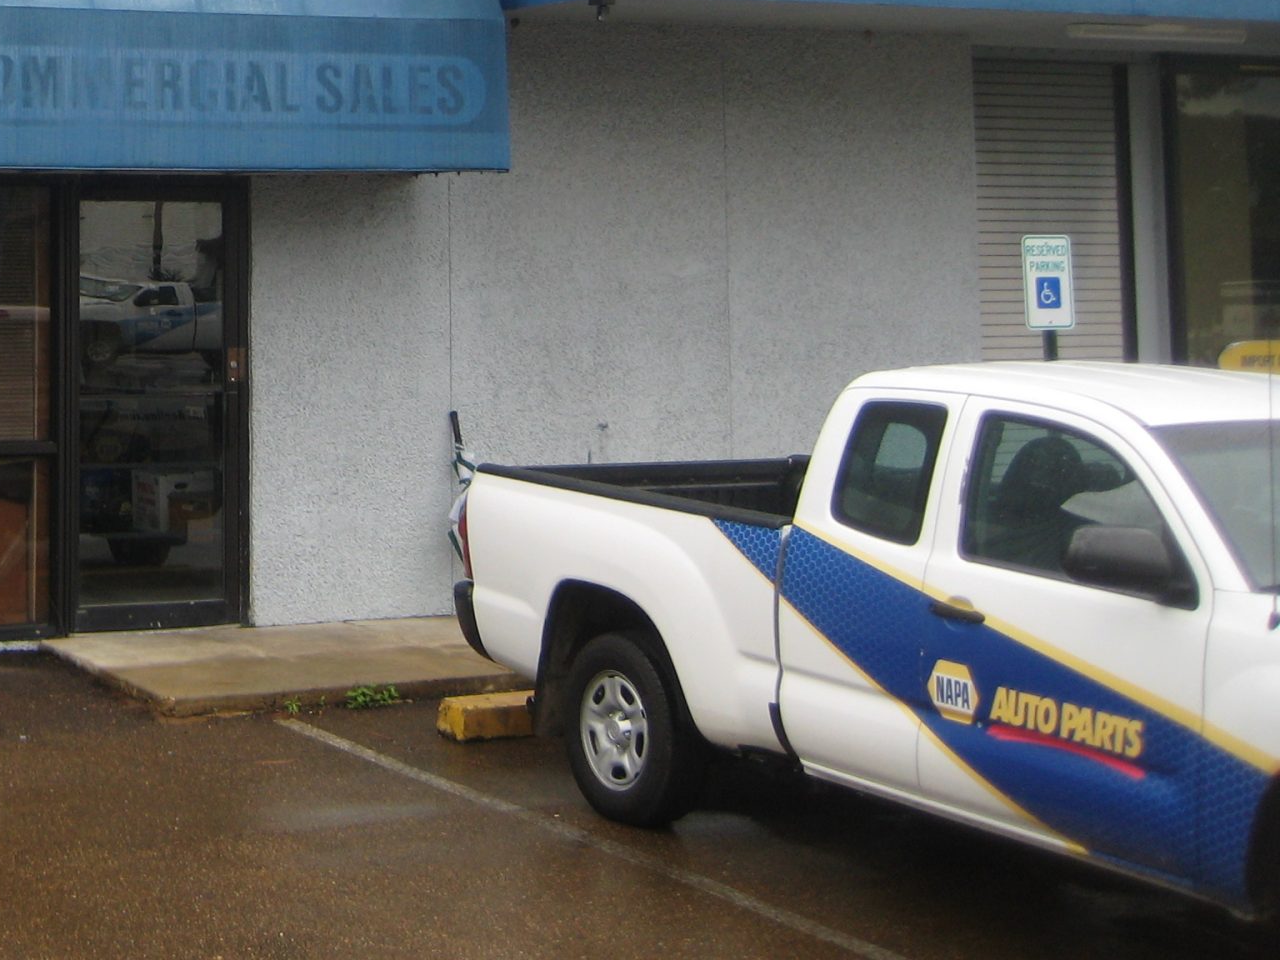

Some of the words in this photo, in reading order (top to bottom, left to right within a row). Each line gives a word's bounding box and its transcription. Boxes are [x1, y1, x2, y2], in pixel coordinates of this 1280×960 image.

[315, 61, 466, 116] SALES
[1024, 244, 1067, 257] RESERVED
[1029, 260, 1066, 272] PARKING
[935, 674, 971, 711] NAPA
[989, 686, 1058, 735] AUTO
[1059, 702, 1144, 759] PARTS
